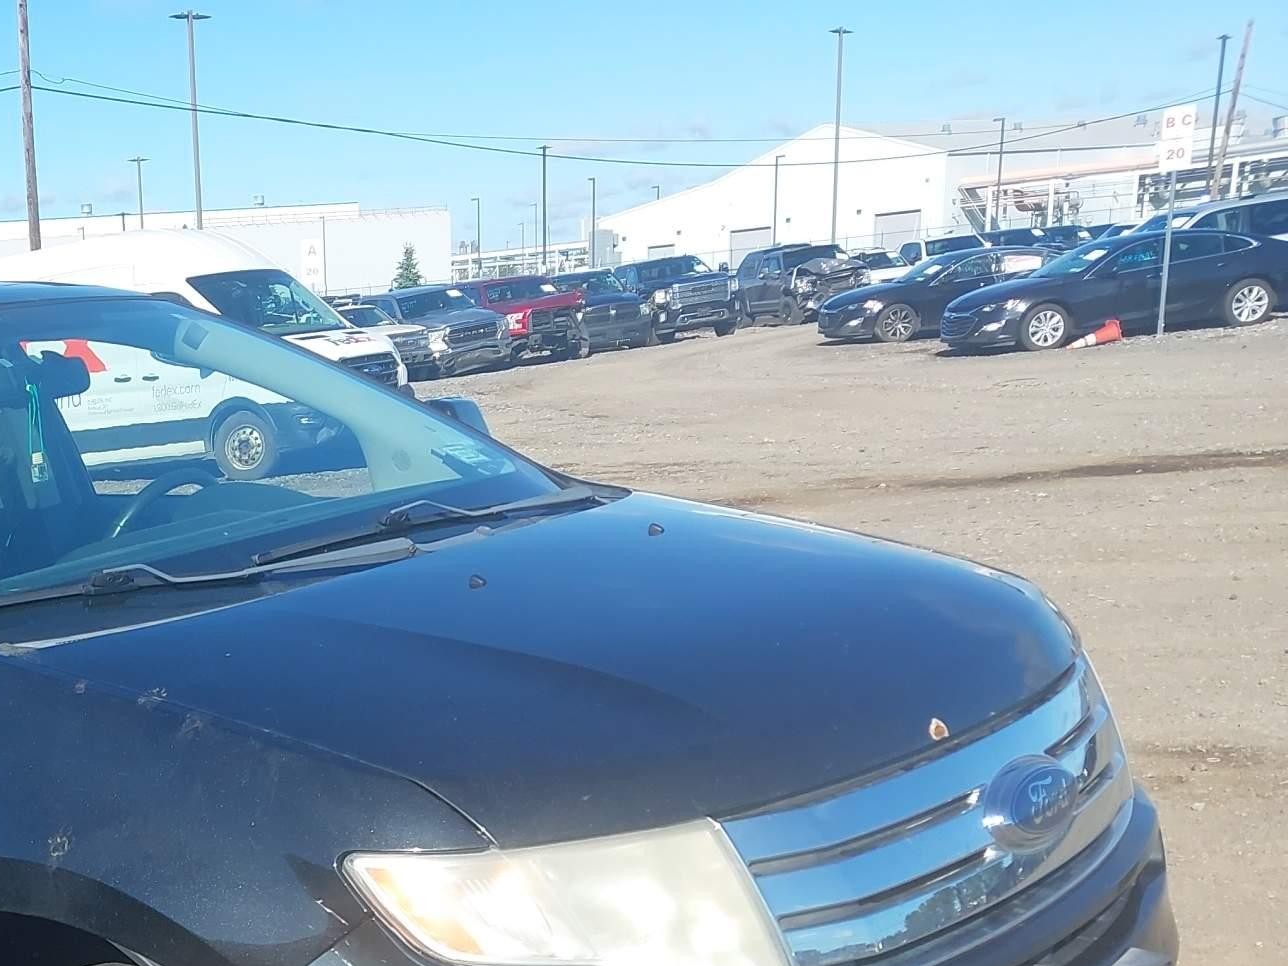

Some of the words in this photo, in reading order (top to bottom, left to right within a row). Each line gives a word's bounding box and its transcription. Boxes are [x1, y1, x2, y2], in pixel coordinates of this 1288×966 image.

[1166, 147, 1185, 160] 20
[307, 245, 317, 256] A
[1028, 775, 1069, 824] Ford
